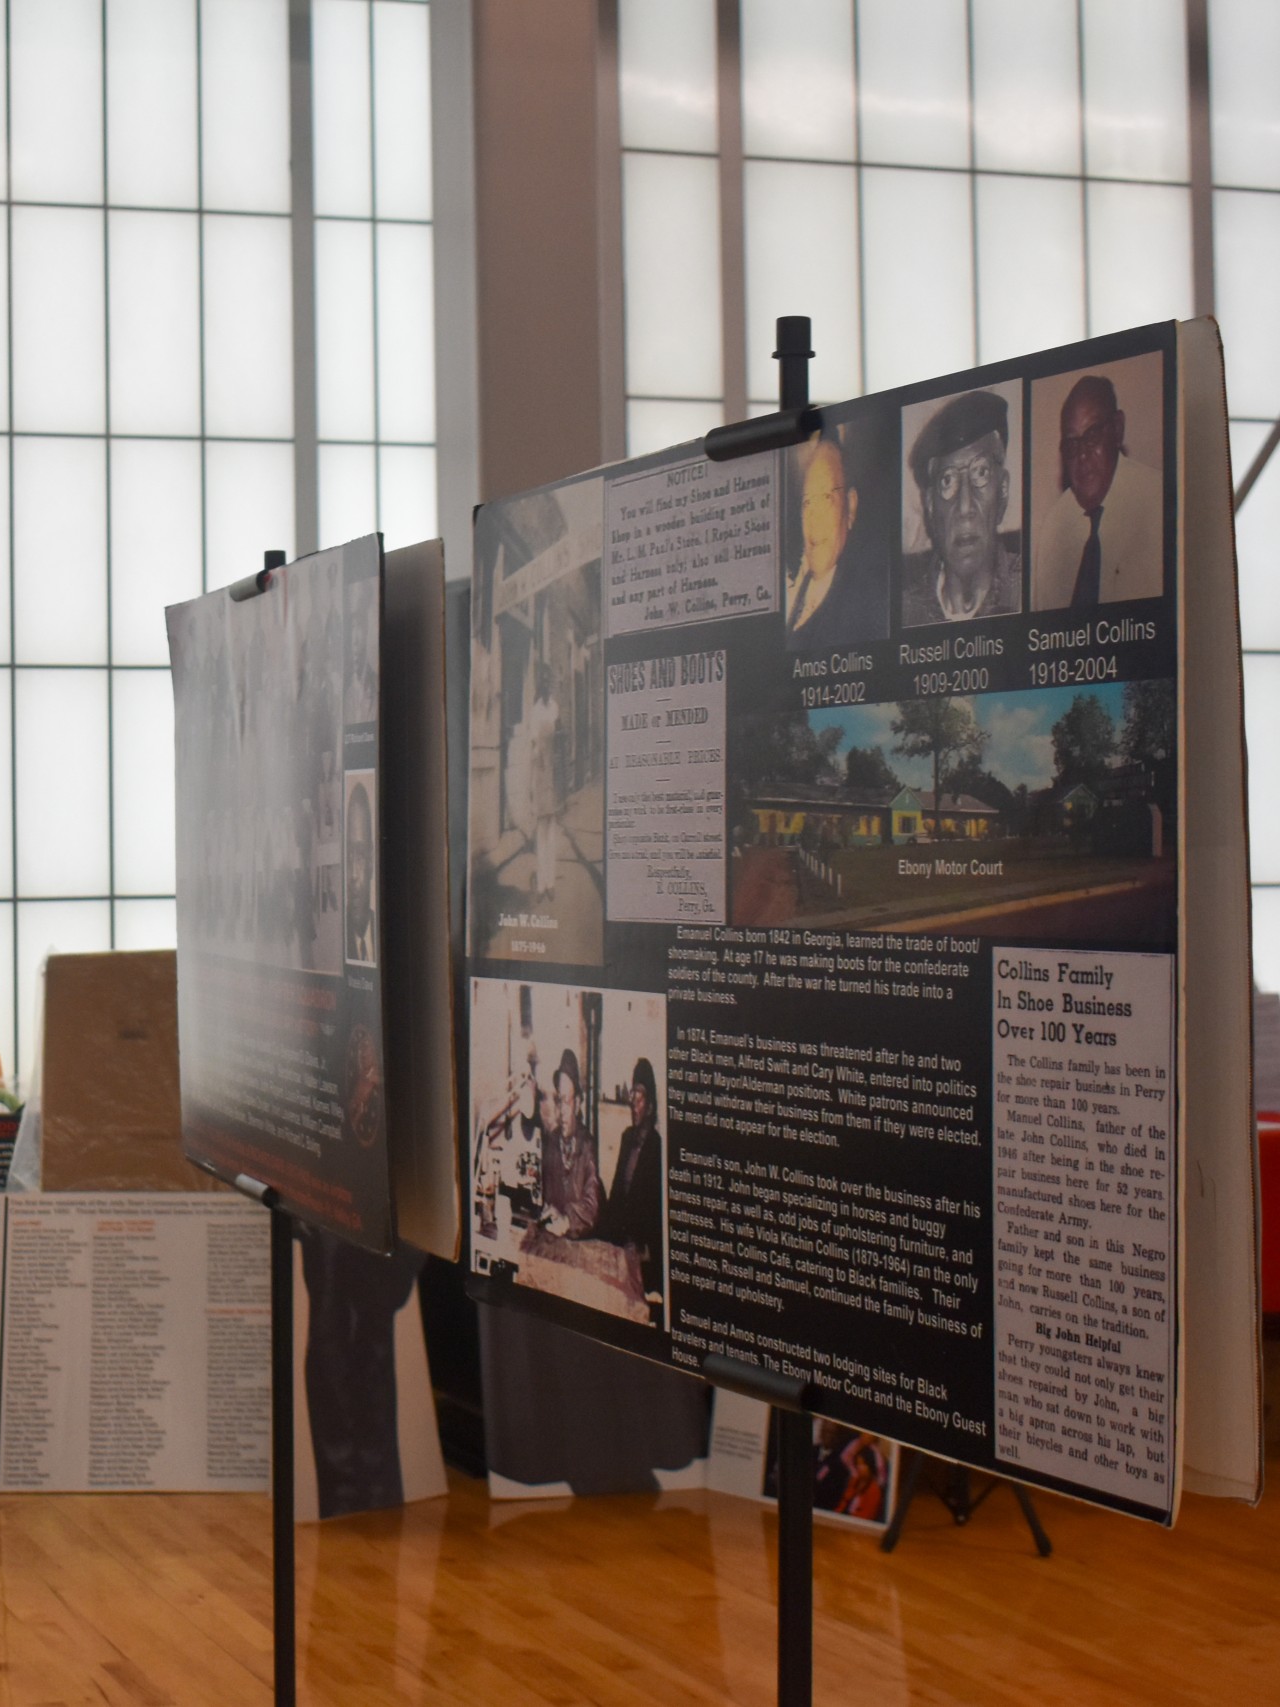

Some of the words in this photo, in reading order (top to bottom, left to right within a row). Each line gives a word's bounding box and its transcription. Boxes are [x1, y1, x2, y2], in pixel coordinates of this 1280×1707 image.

[900, 639, 949, 665] Russell
[954, 635, 1003, 659] Collins
[1029, 623, 1090, 652] Samuel
[1096, 618, 1155, 645] Collins
[609, 661, 646, 694] SHOES
[650, 656, 676, 689] AND
[680, 651, 724, 685] BOOTS
[793, 658, 827, 678] Amos
[831, 651, 873, 674] Collins
[1030, 655, 1117, 685] 1918-2004
[801, 681, 865, 707] 1914-2002
[914, 667, 988, 695] 1909-2000
[621, 713, 648, 731] MADE
[651, 715, 662, 728] or
[665, 707, 709, 727] MENDED
[898, 859, 932, 879] Ebony
[935, 859, 967, 876] Motor
[970, 859, 1003, 876] Court
[677, 922, 712, 941] Emanuel
[714, 924, 743, 943] Collins
[746, 928, 766, 943] born
[769, 929, 790, 945] 1842
[792, 930, 801, 944] in
[803, 931, 844, 951] Georgia,
[846, 932, 883, 949] learned
[886, 934, 902, 950] the
[906, 936, 933, 952] trade
[936, 936, 947, 952] of
[951, 937, 979, 954] boot/
[668, 946, 718, 966] shoemaking.
[723, 948, 733, 963] At
[735, 952, 751, 967] age
[754, 949, 763, 964] 17
[766, 951, 777, 966] he
[779, 954, 797, 967] was
[800, 953, 834, 973] making
[837, 954, 865, 971] boots
[868, 956, 882, 972] for
[885, 957, 901, 973] the
[904, 959, 969, 978] confederate
[998, 959, 1049, 983] Collins
[1058, 962, 1113, 989] Family
[666, 986, 695, 1004] private
[697, 988, 736, 1005] business.
[668, 966, 700, 981] soldiers
[702, 968, 710, 982] of
[712, 968, 725, 983] the
[728, 971, 758, 989] county.
[764, 971, 785, 987] After
[788, 974, 802, 989] the
[805, 978, 822, 990] war
[825, 975, 836, 992] he
[839, 978, 871, 994] turned
[874, 979, 889, 995] his
[892, 982, 919, 998] trade
[923, 983, 943, 1000] into
[947, 987, 953, 1000] a
[998, 989, 1011, 1010] In
[1017, 990, 1053, 1012] Shoe
[1063, 993, 1132, 1018] Business
[997, 1018, 1034, 1041] Over
[1042, 1021, 1065, 1043] 100
[1074, 1023, 1116, 1047] Years
[1007, 1054, 1025, 1068] The
[1029, 1056, 1063, 1071] Collins
[1068, 1058, 1100, 1077] family
[1104, 1061, 1120, 1076] has
[1126, 1063, 1150, 1078] been
[1156, 1065, 1166, 1080] in
[997, 1071, 1012, 1085] the
[1041, 1077, 1070, 1091] repair
[1120, 1083, 1130, 1097] in
[1135, 1083, 1165, 1102] Perry
[997, 1089, 1010, 1103] for
[1015, 1095, 1039, 1107] more
[1043, 1095, 1065, 1110] than
[1072, 1098, 1088, 1113] 100
[1092, 1103, 1119, 1115] years.
[1036, 1321, 1051, 1340] Big
[1056, 1326, 1080, 1344] John
[1085, 1333, 1120, 1354] Helpful
[672, 1347, 700, 1367] House.
[680, 1308, 710, 1330] Samuel
[712, 1321, 728, 1336] and
[730, 1323, 755, 1343] Amos
[757, 1334, 811, 1360] constructed
[813, 1349, 830, 1366] two
[833, 1353, 870, 1381] lodging
[873, 1365, 897, 1386] sites
[900, 1372, 914, 1390] for
[918, 1377, 946, 1401] Black
[672, 1327, 707, 1350] travelers
[709, 1340, 724, 1355] and
[724, 1342, 761, 1366] tenants.
[763, 1353, 780, 1373] The
[782, 1360, 812, 1384] Ebony
[814, 1369, 841, 1391] Motor
[843, 1376, 872, 1401] Court
[874, 1391, 893, 1408] and
[896, 1394, 912, 1414] the
[915, 1399, 949, 1427] Ebony
[952, 1411, 985, 1437] Guest
